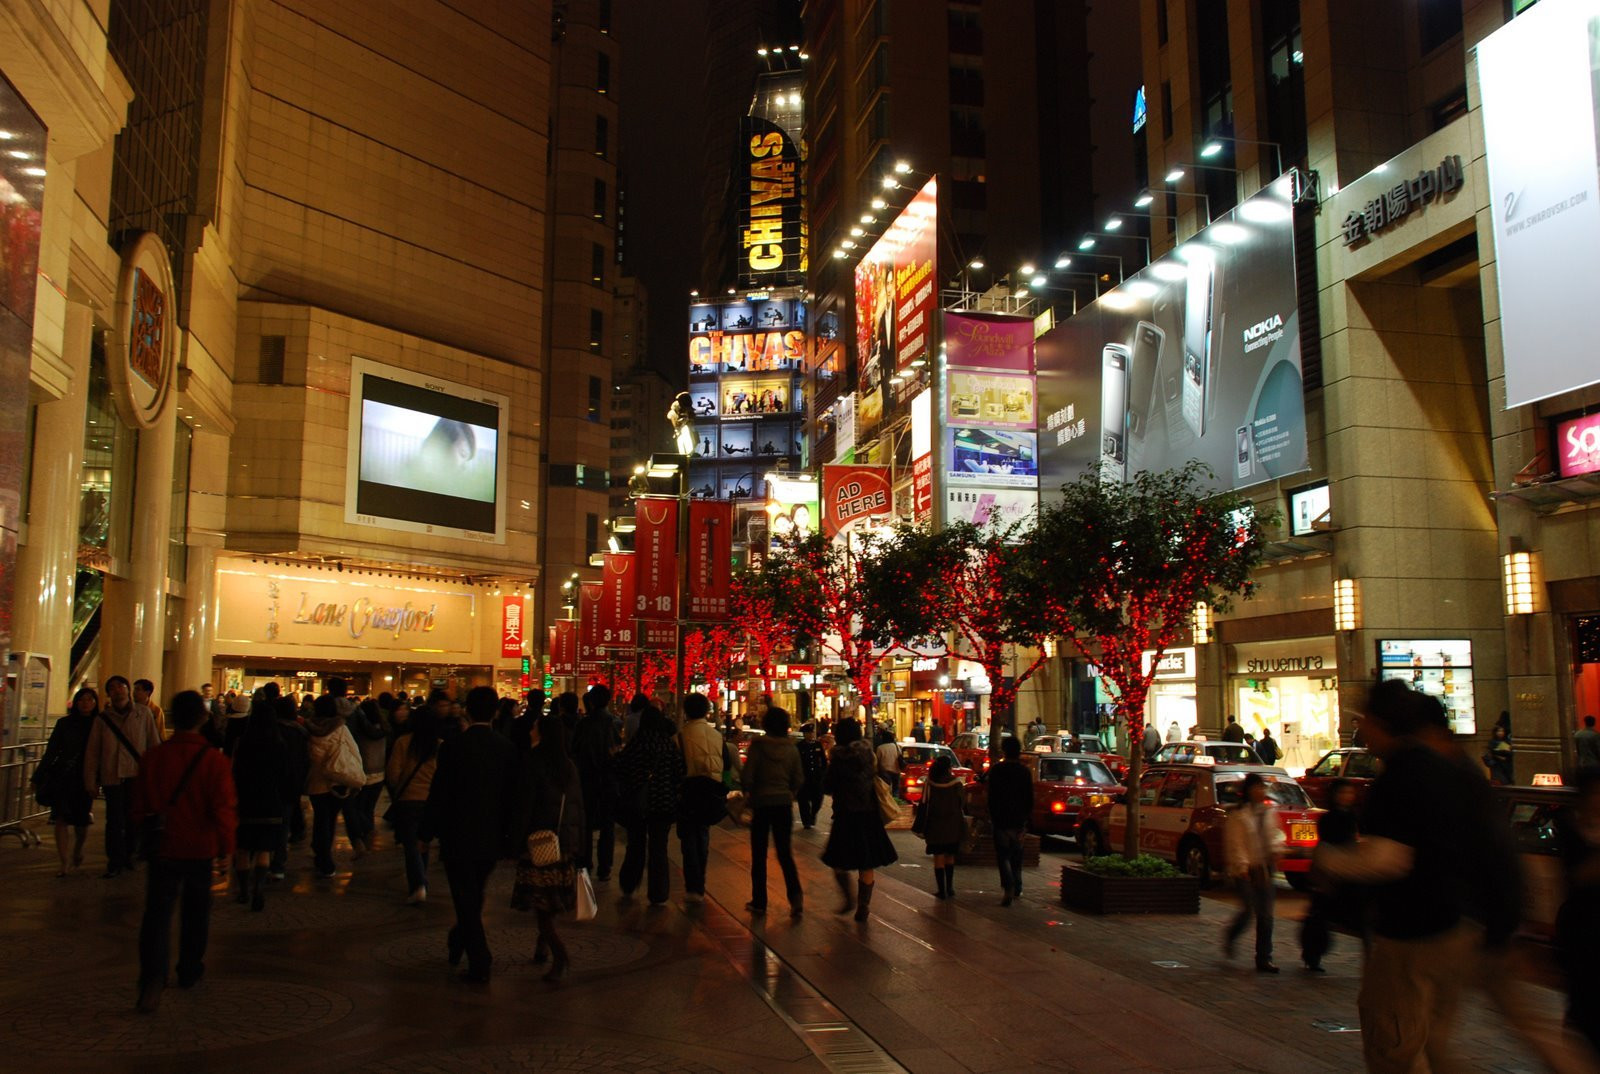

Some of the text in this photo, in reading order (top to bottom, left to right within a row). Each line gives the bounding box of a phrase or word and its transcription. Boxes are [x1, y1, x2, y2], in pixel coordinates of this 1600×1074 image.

[782, 161, 795, 198] LIFE
[749, 131, 784, 271] CHIVAS
[1342, 155, 1465, 247] 金朝陽中心
[1506, 190, 1588, 237] WWW.SWAROVSKI.COM
[1243, 314, 1283, 342] NOKIA
[1244, 328, 1284, 353] Connecting People
[689, 331, 805, 365] CHIVAS
[424, 382, 446, 392] SONY
[837, 482, 862, 503] AD
[837, 490, 887, 521] HERE
[293, 592, 438, 639] Lane Crawford
[1247, 654, 1323, 673] shu uemura
